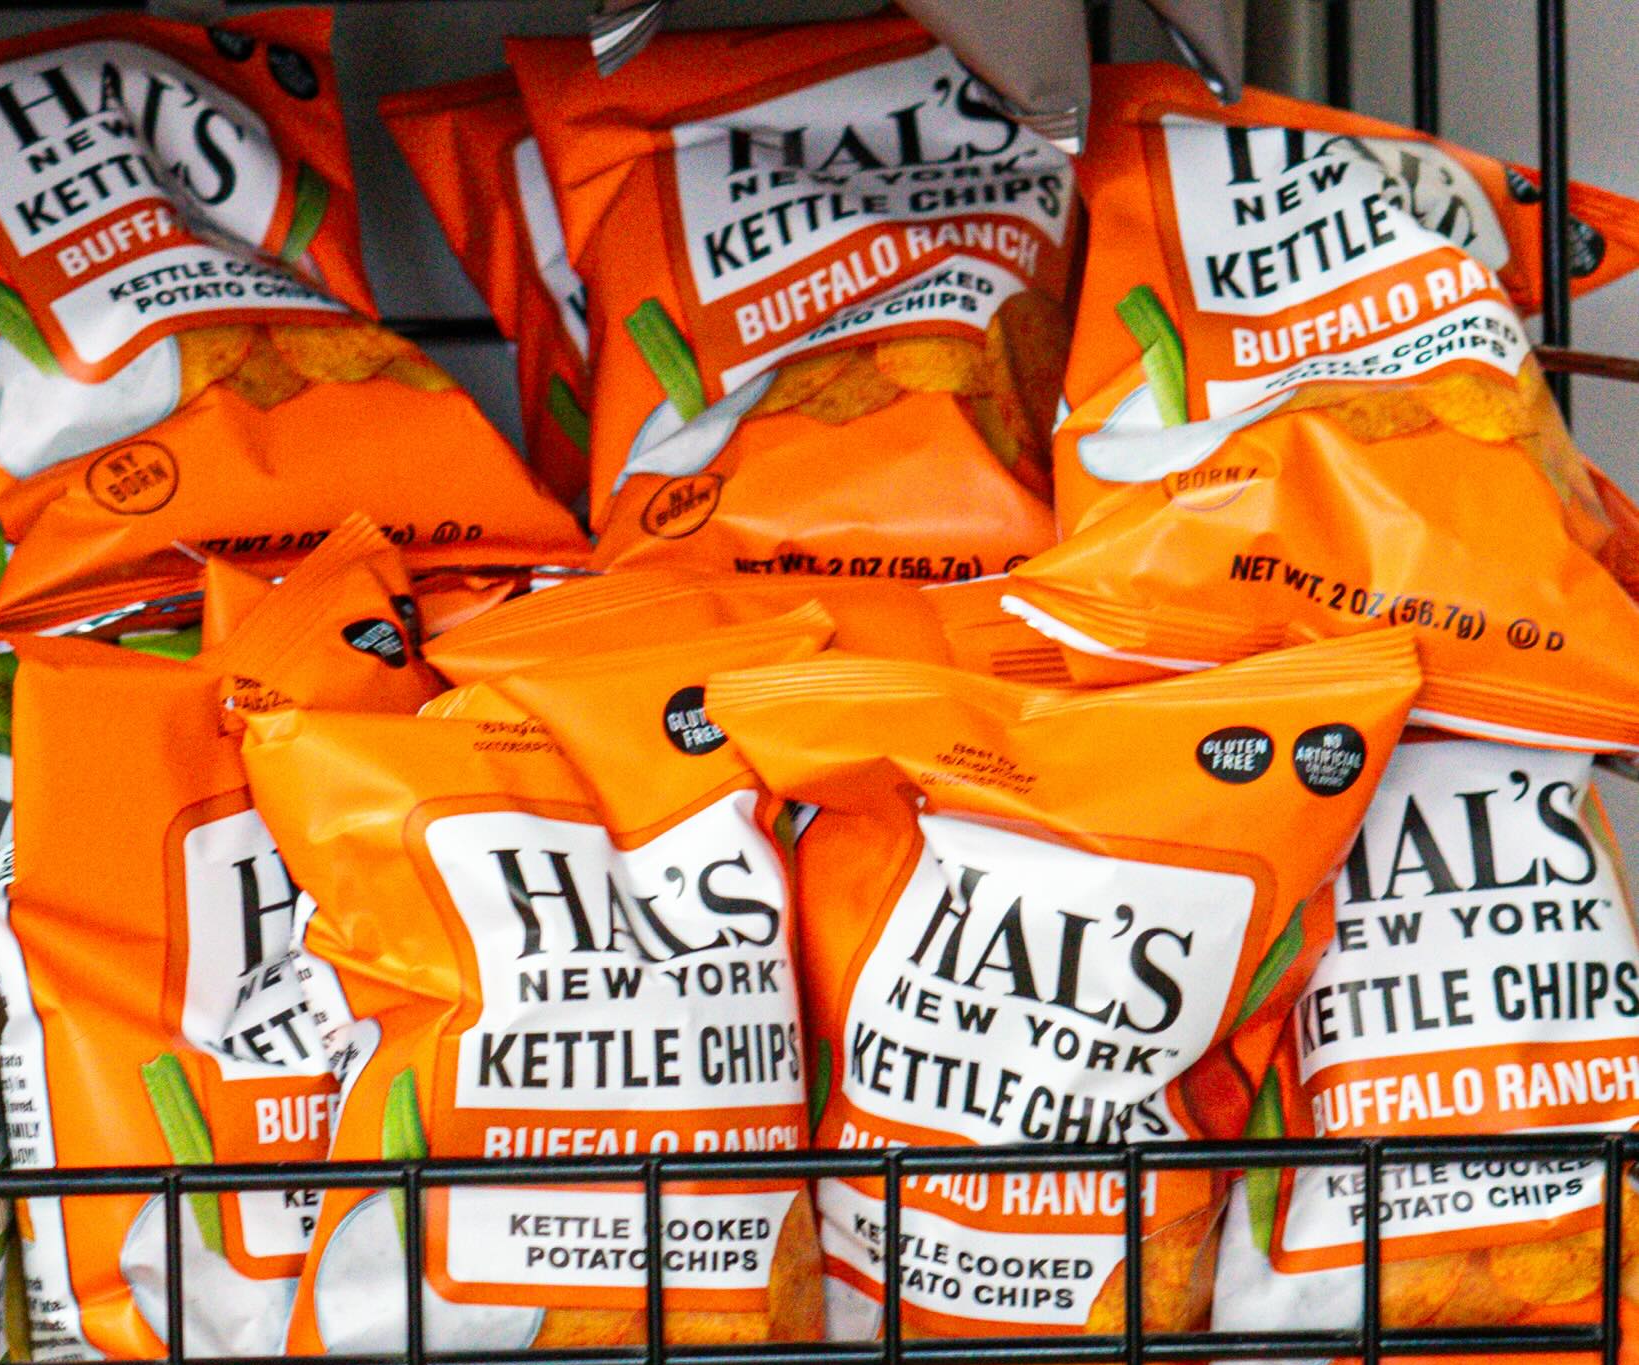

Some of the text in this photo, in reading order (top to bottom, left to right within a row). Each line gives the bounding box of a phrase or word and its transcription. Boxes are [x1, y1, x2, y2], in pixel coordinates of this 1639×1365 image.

[724, 75, 1021, 176] HAL'S
[729, 152, 1023, 204] NEW YORK
[1233, 162, 1351, 226] NEW
[704, 172, 1067, 280] KETTLE CHIPS
[1207, 191, 1399, 300] KETTLE
[735, 222, 1041, 346] BUFFALO RANCH
[1233, 280, 1422, 368] BUFFALO
[1229, 555, 1486, 643] NET WT. 2 OZ (56.7g)
[1203, 738, 1268, 760] GLUTEN
[488, 848, 781, 963] HAL'S
[908, 856, 1193, 1036] HAL'S
[1452, 903, 1601, 941] YORK
[517, 959, 780, 1002] NEW YORK
[1300, 960, 1639, 1056] KETTLE CHIPS
[477, 1021, 800, 1090] KETTLE CHIPS
[886, 975, 1163, 1077] NEW YORK
[850, 1022, 1023, 1131] KETTLE
[1313, 1055, 1639, 1138] BUFFALO RANCH
[508, 1213, 631, 1242] KETTLE
[1487, 1178, 1583, 1206] CHIPS
[665, 1245, 759, 1272] CHIPS
[956, 1248, 1094, 1281] COOKED
[973, 1283, 1074, 1310] CHIPS
